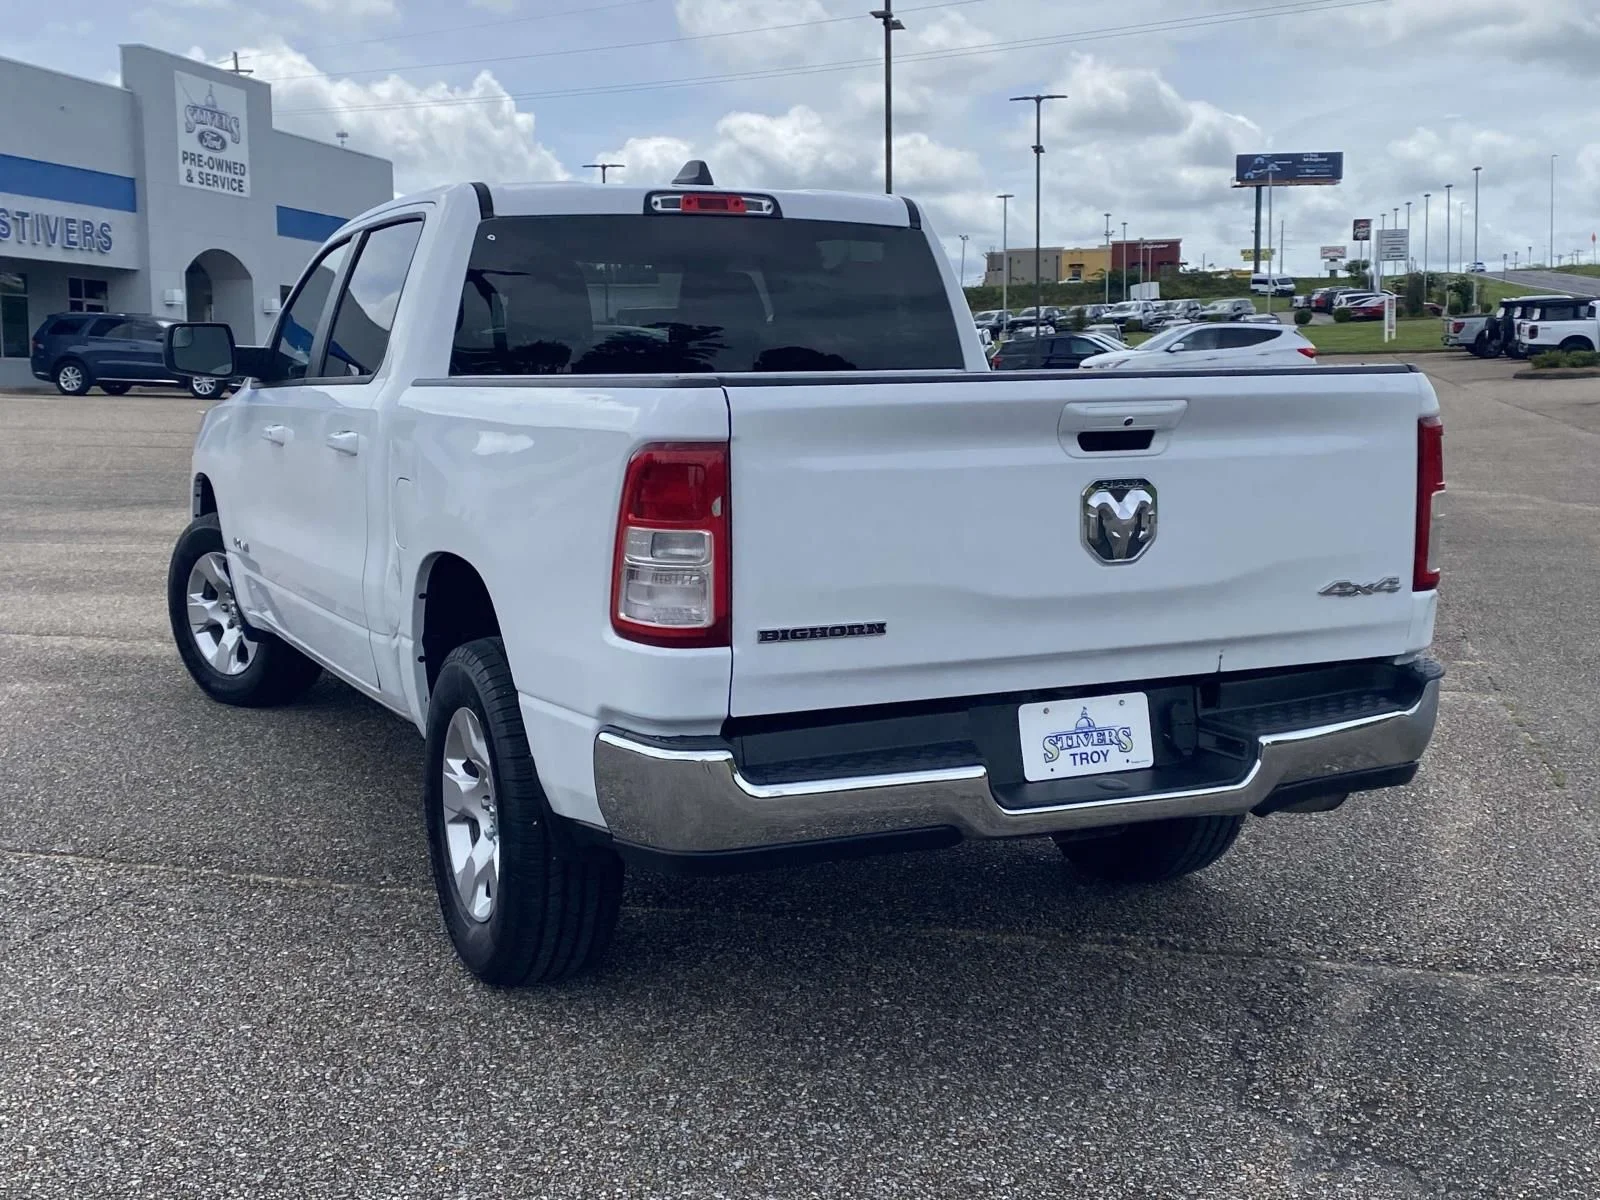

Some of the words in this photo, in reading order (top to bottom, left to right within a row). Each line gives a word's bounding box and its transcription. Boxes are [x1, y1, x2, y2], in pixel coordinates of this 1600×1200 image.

[184, 104, 240, 145] STIVERS
[182, 150, 246, 177] PRE-OWNED
[186, 168, 194, 184] &
[198, 171, 245, 193] SERVICE
[757, 622, 887, 644] BIGHORN
[1042, 726, 1133, 763] STIVERS
[1069, 750, 1110, 766] TROY
